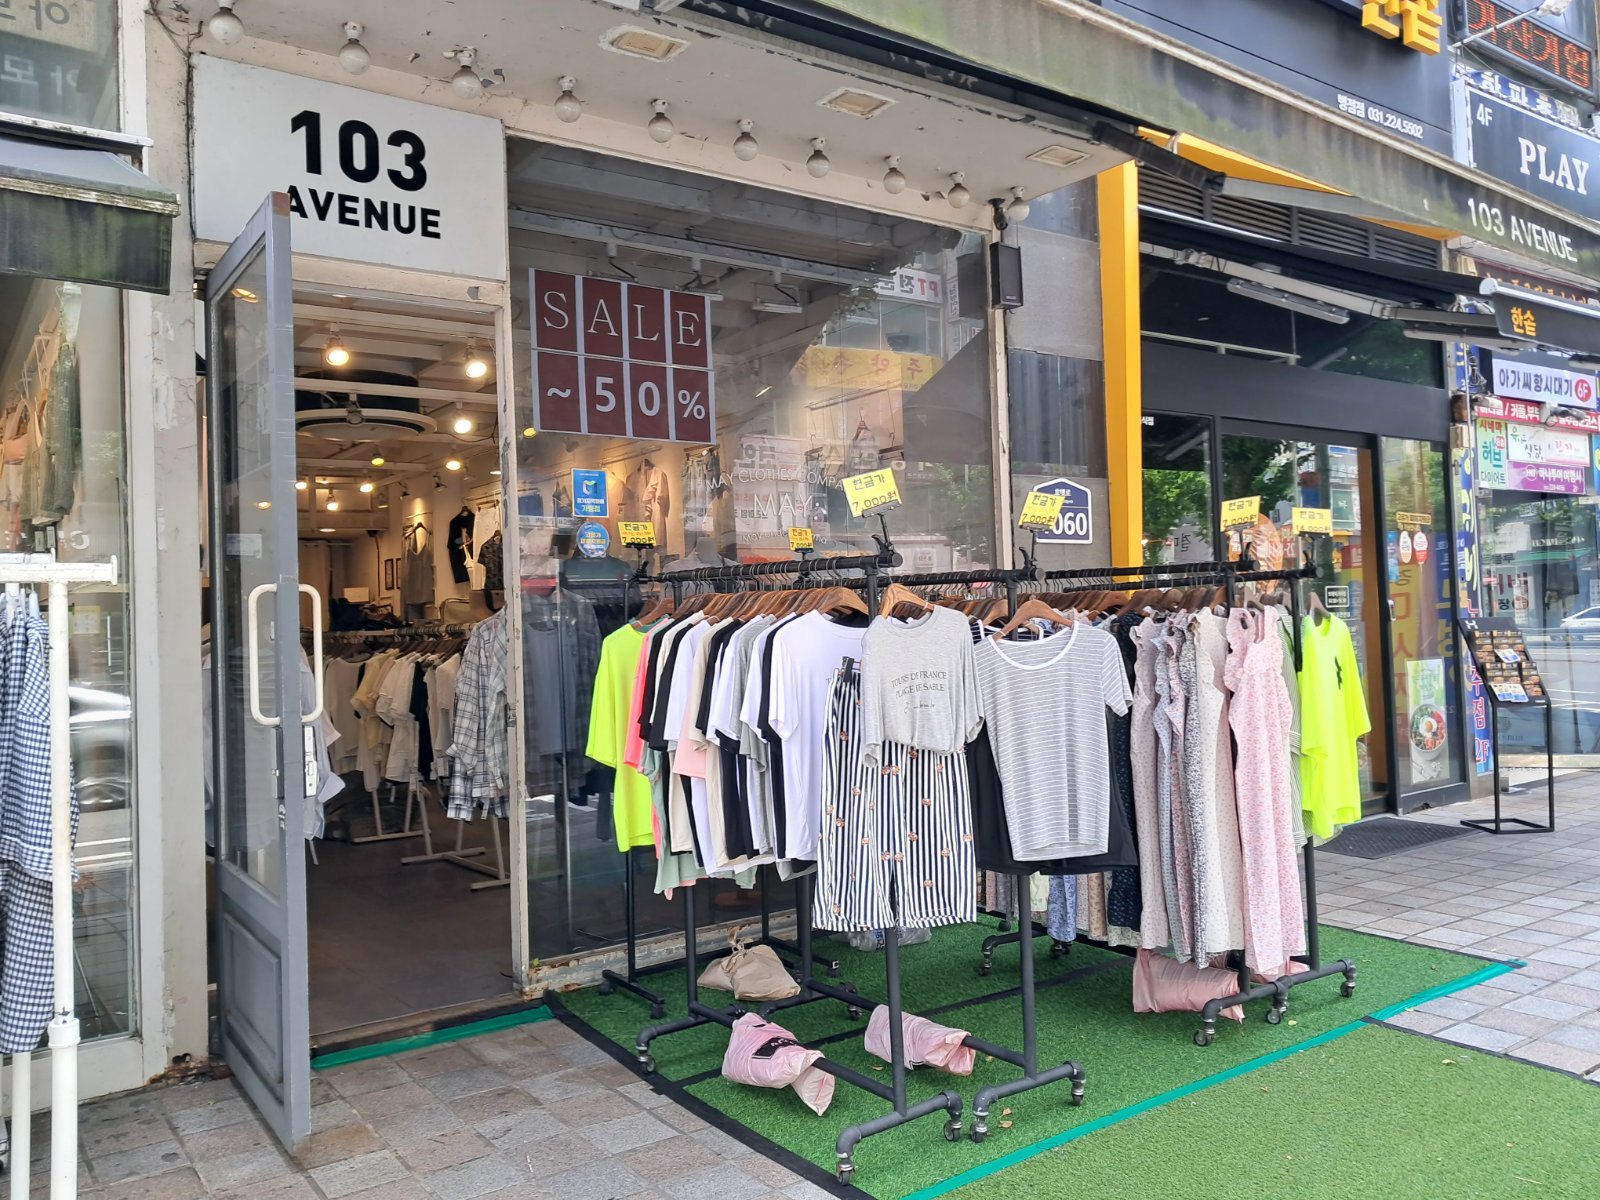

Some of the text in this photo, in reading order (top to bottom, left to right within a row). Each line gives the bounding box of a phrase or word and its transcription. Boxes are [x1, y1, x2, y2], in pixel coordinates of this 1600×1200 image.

[1367, 106, 1423, 139] 031.224.5502
[1477, 104, 1493, 127] 4F
[291, 110, 427, 192] 103
[1518, 137, 1589, 195] PLAY
[287, 185, 441, 239] AVENUE
[1467, 198, 1578, 263] 103 AVENUE
[543, 291, 701, 347] SALE
[1510, 306, 1537, 337] 한솥
[1499, 368, 1573, 397] 아가씨항시대기
[705, 471, 734, 491] MAY
[738, 468, 793, 483] CLOTHES
[853, 473, 887, 491] 현금가
[1480, 471, 1506, 485] 다이어트
[753, 492, 813, 518] MAY
[624, 523, 648, 531] 현금가
[1044, 512, 1088, 535] 060
